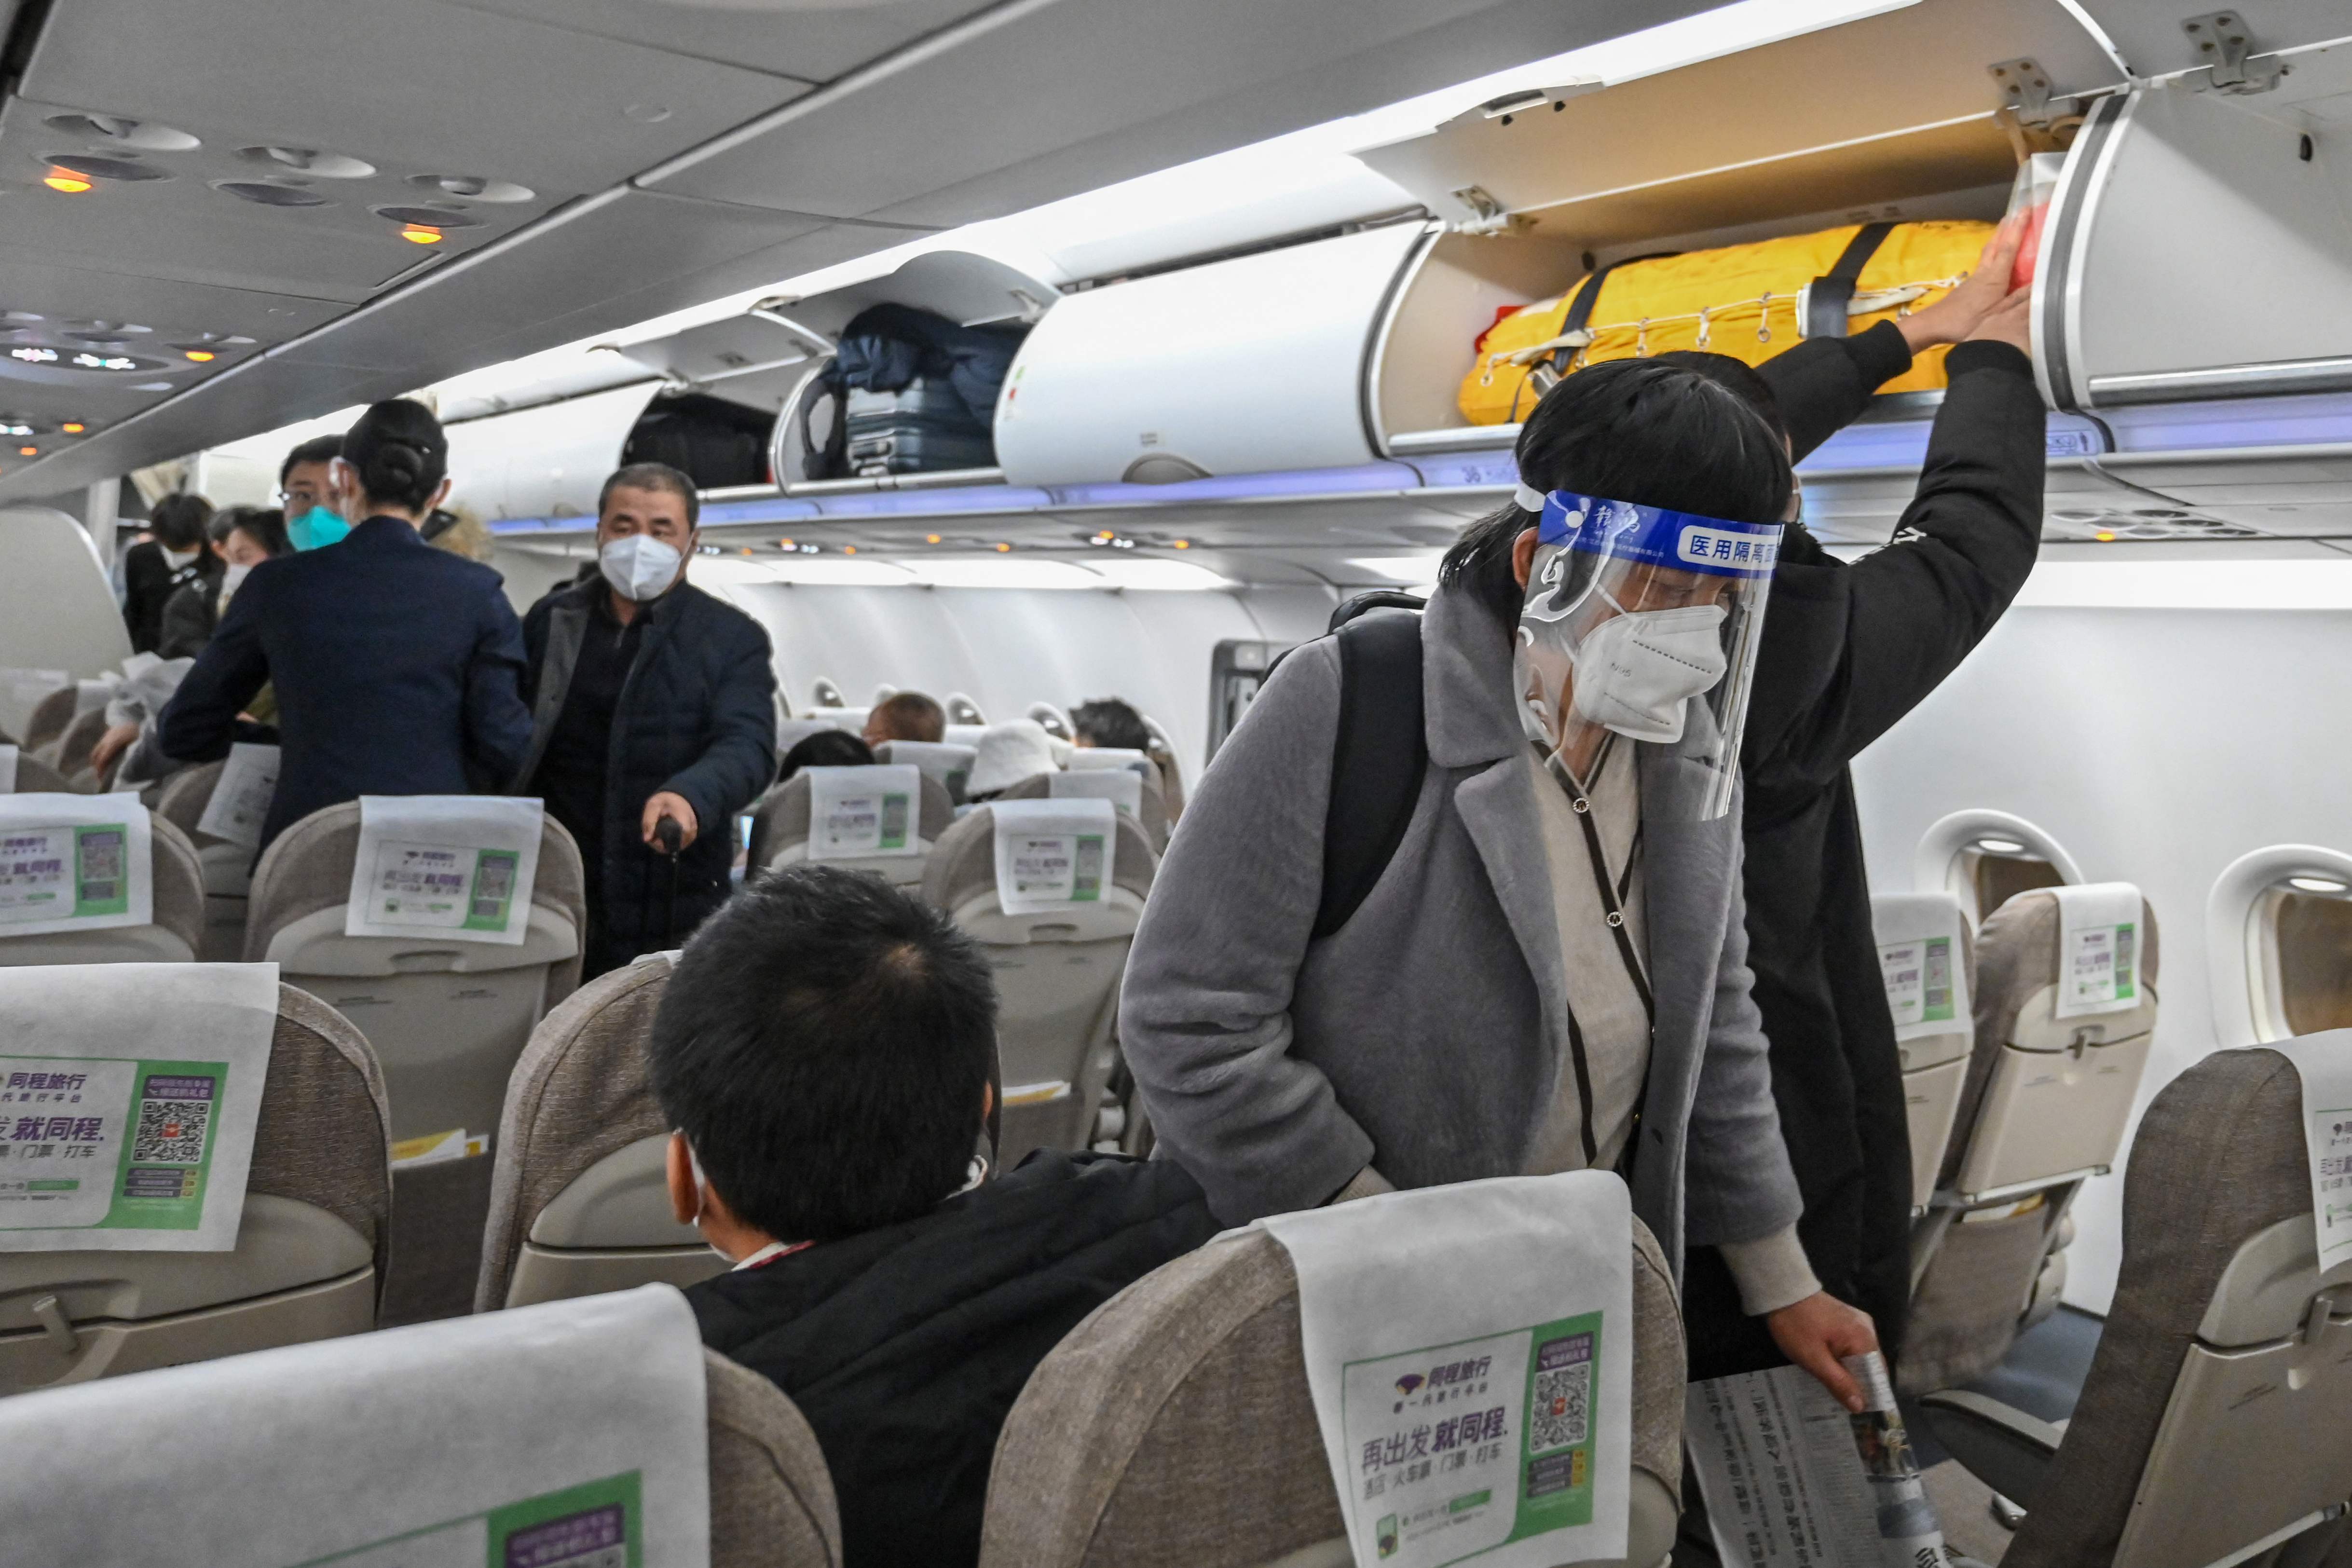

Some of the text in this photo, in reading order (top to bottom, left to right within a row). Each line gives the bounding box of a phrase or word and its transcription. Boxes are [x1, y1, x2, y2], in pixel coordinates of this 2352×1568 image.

[6, 1072, 87, 1090] 同程旅行
[1426, 1355, 1492, 1389] 同程旅行
